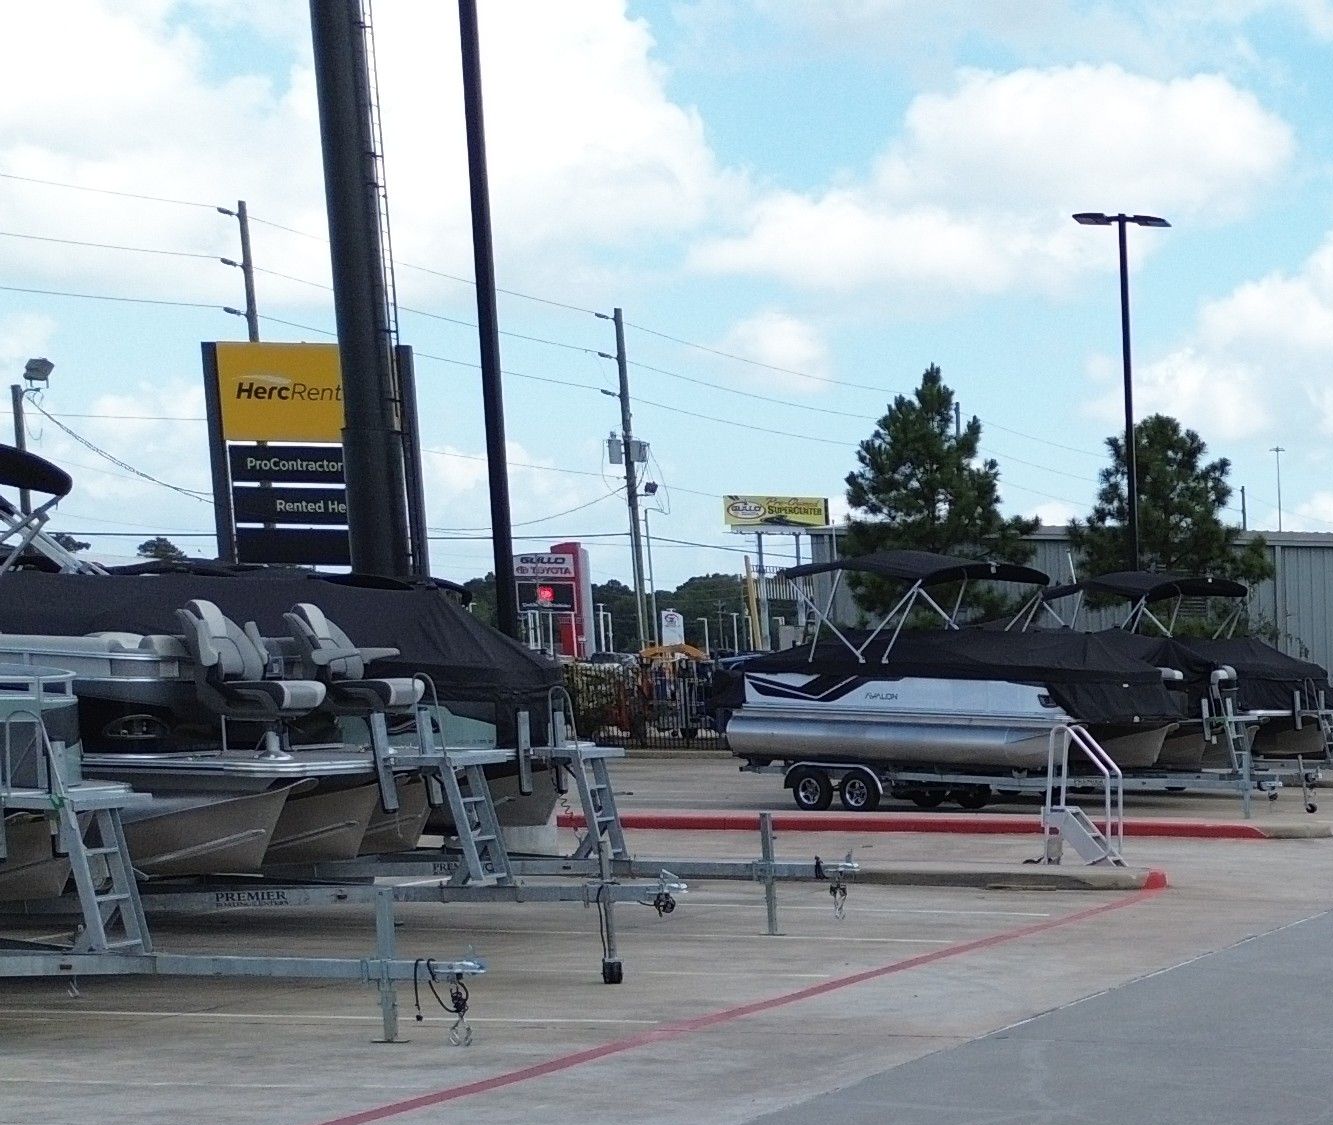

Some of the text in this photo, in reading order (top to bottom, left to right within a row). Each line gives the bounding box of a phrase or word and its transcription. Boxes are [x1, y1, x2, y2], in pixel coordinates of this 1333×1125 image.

[276, 500, 325, 513] Rented
[530, 566, 571, 575] TOYOTA
[864, 692, 898, 701] AVALON
[215, 890, 287, 902] PREMIER
